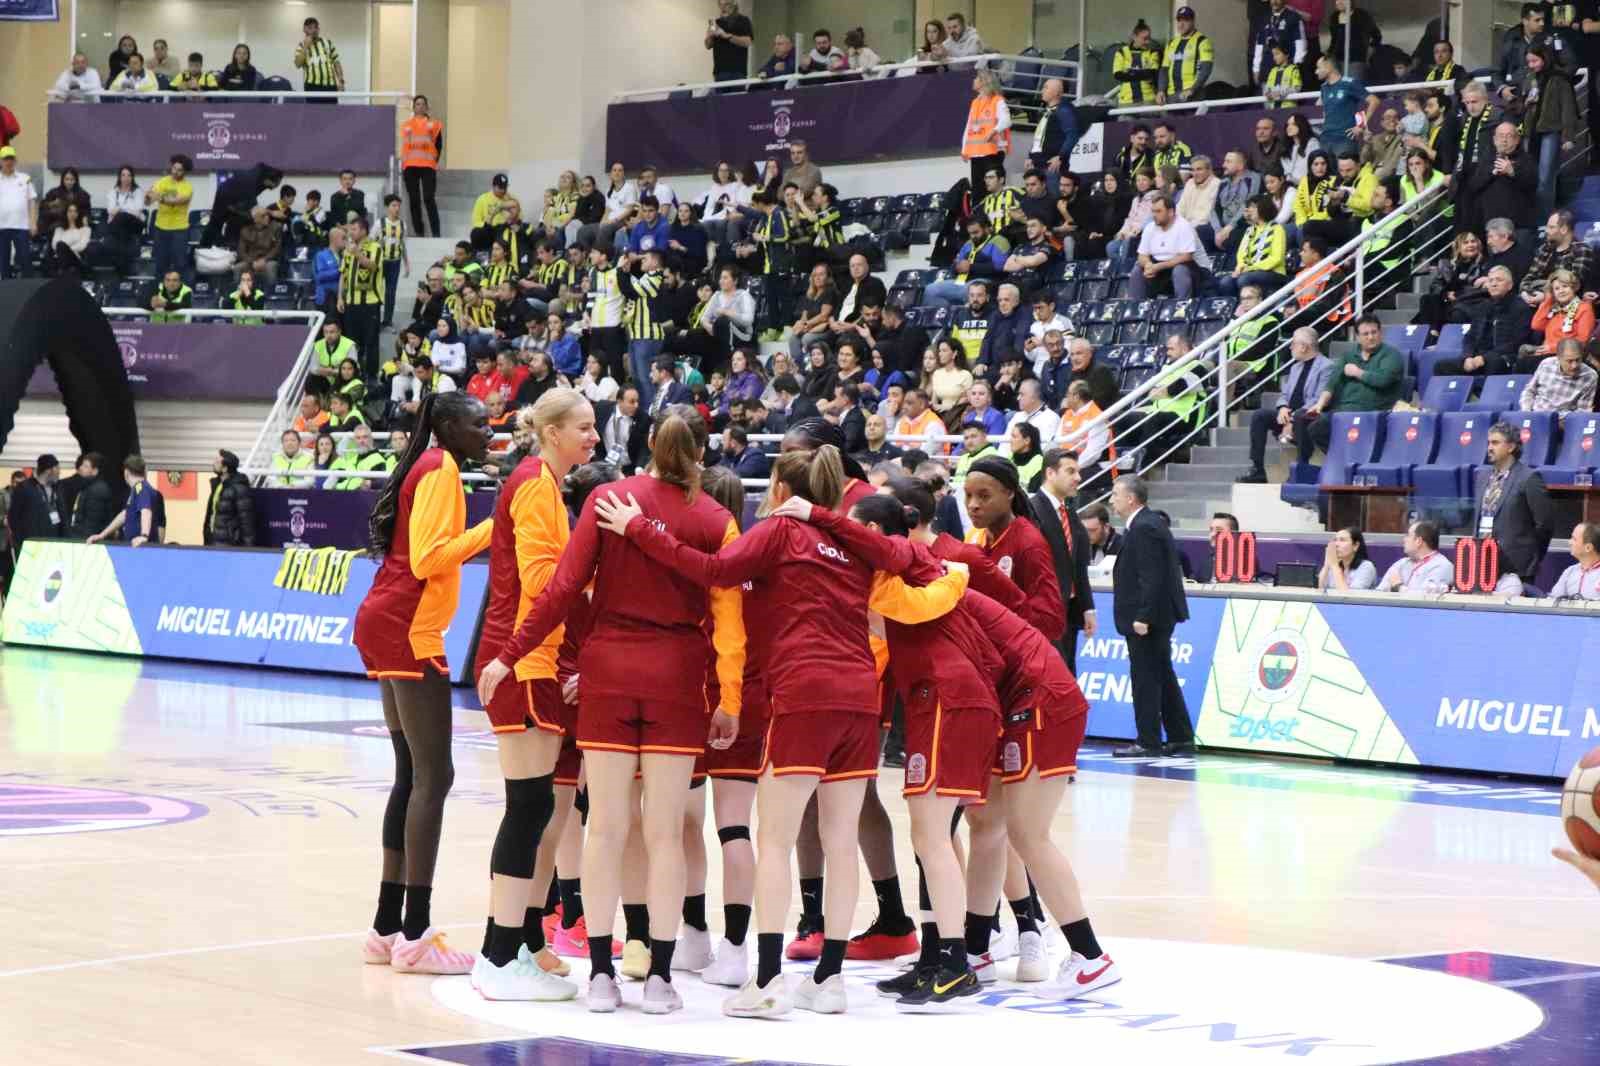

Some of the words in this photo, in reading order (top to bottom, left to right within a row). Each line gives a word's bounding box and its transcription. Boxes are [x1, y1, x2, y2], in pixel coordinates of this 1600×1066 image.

[157, 604, 231, 637] MIGUEL
[235, 610, 349, 645] MARTINEZ
[1435, 696, 1571, 737] MIGUEL
